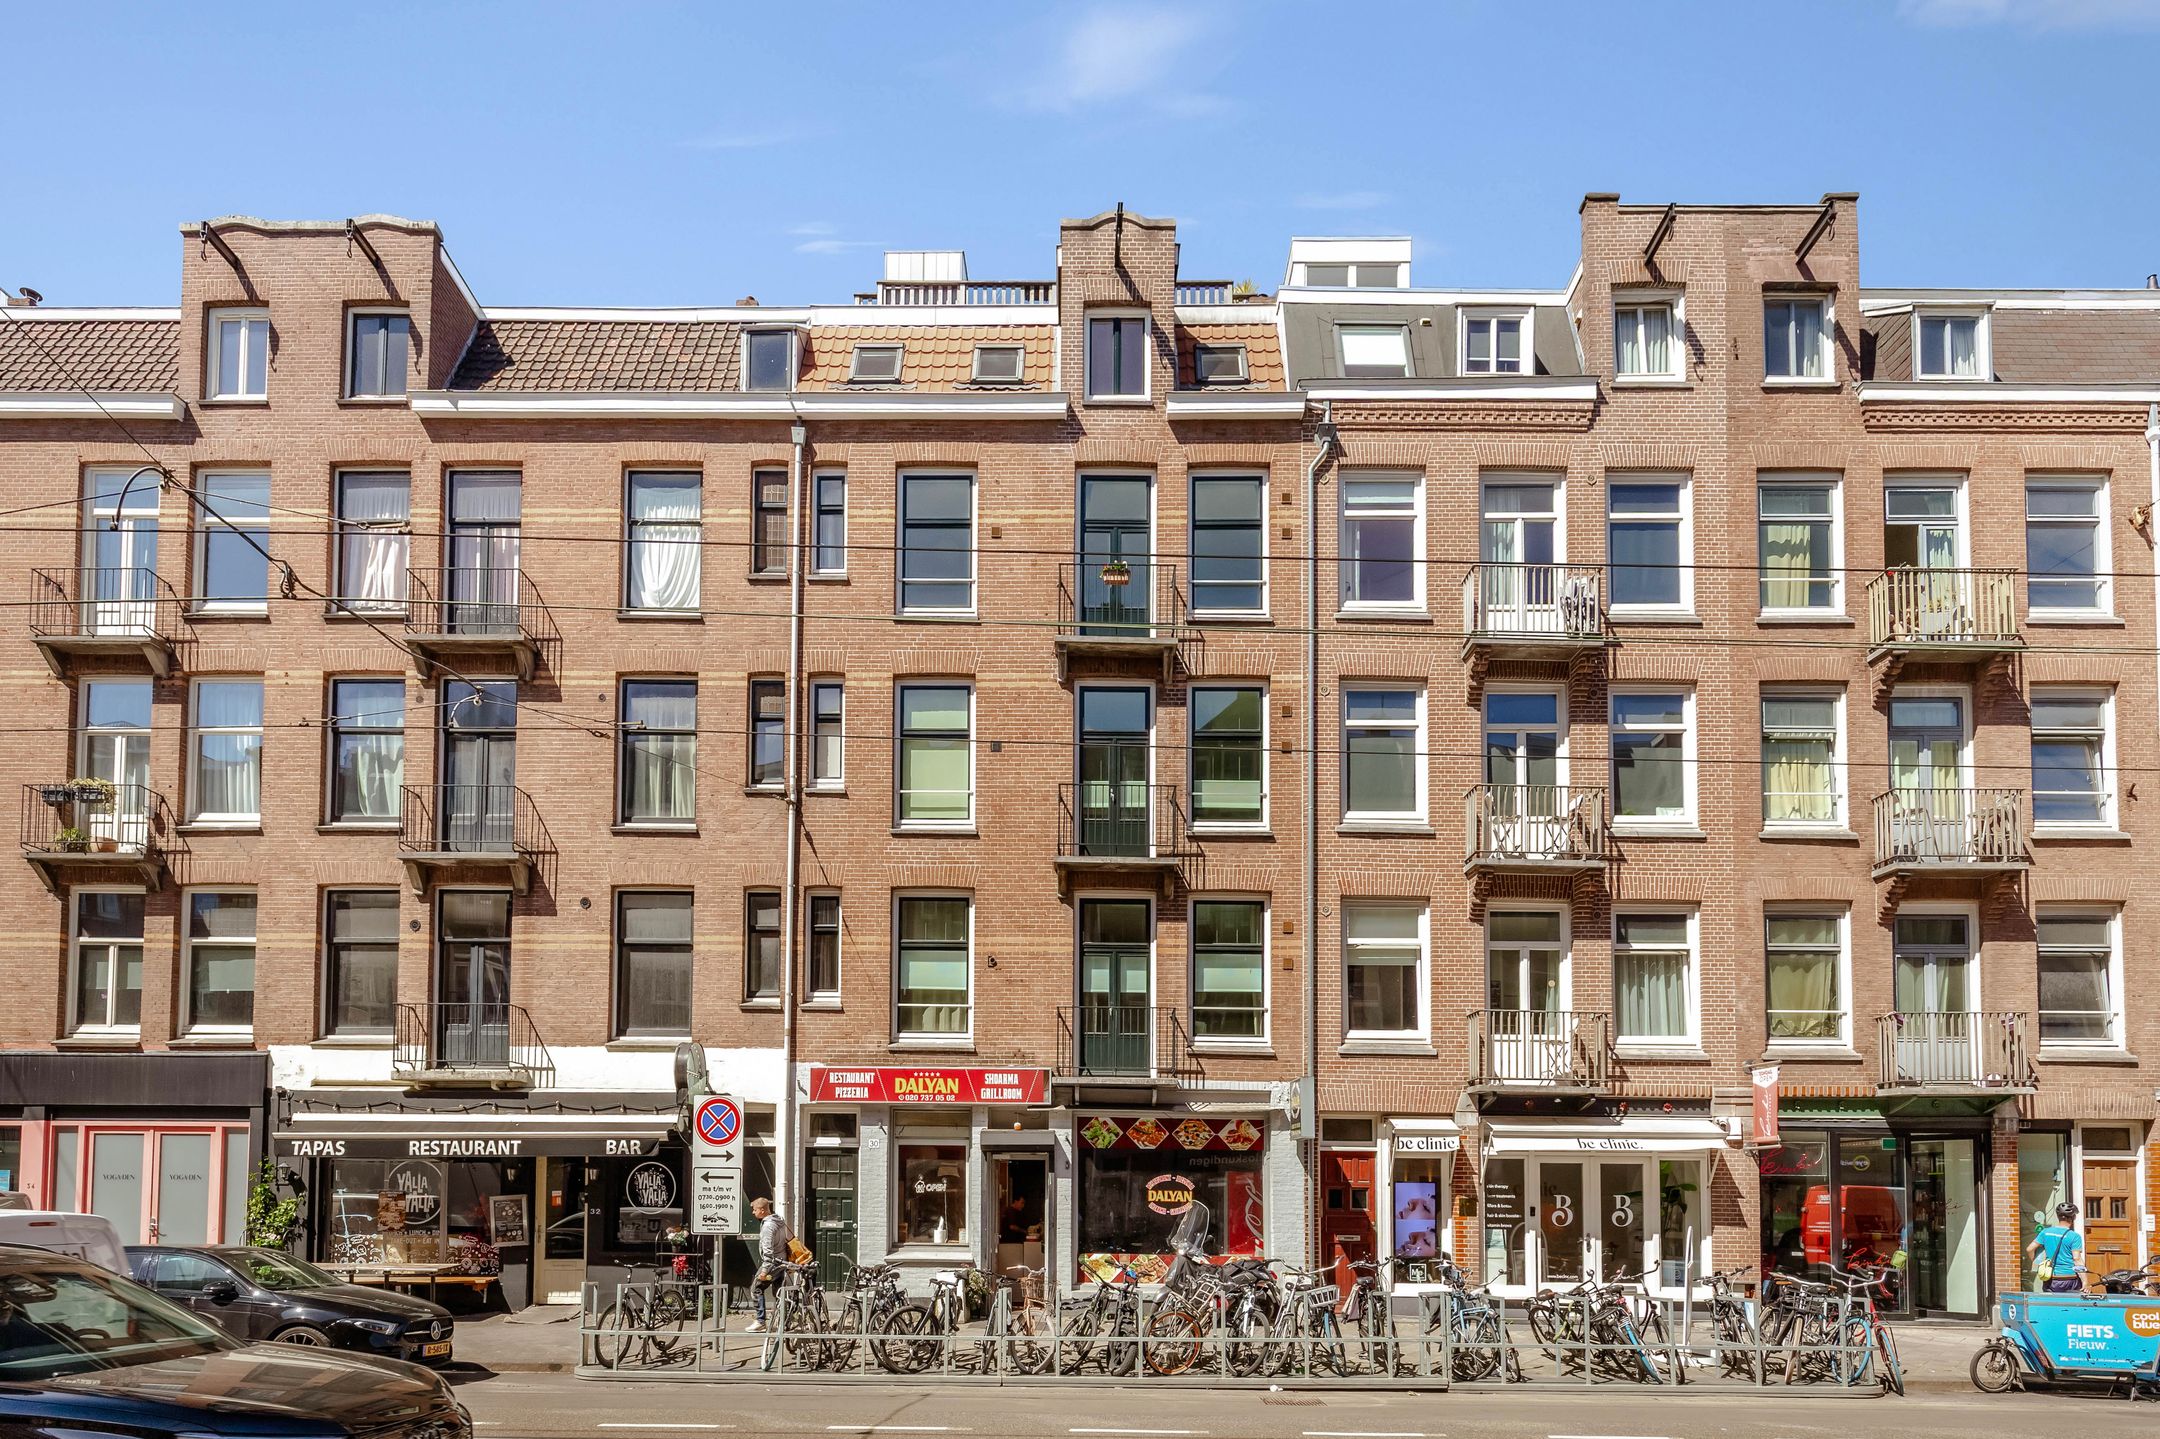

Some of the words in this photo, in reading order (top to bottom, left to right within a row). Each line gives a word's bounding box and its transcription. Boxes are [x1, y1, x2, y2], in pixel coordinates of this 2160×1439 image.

[829, 1072, 875, 1083] RESTAURANT
[985, 1073, 1019, 1084] SHOARMA
[895, 1078, 959, 1094] DALYAN
[835, 1087, 869, 1098] PIZZERIA
[981, 1088, 1022, 1099] GRILLROOM
[291, 1140, 345, 1155] TAPAS
[409, 1140, 522, 1155] RESTAURANT
[605, 1140, 641, 1155] BAR
[1397, 1136, 1414, 1149] be
[1577, 1138, 1596, 1149] be
[397, 1171, 428, 1193] YALLA
[636, 1171, 661, 1189] YALLA
[926, 1183, 947, 1192] OPEN
[1148, 1190, 1193, 1201] DALYAN
[2132, 1311, 2159, 1321] cool
[2133, 1319, 2160, 1329] blue
